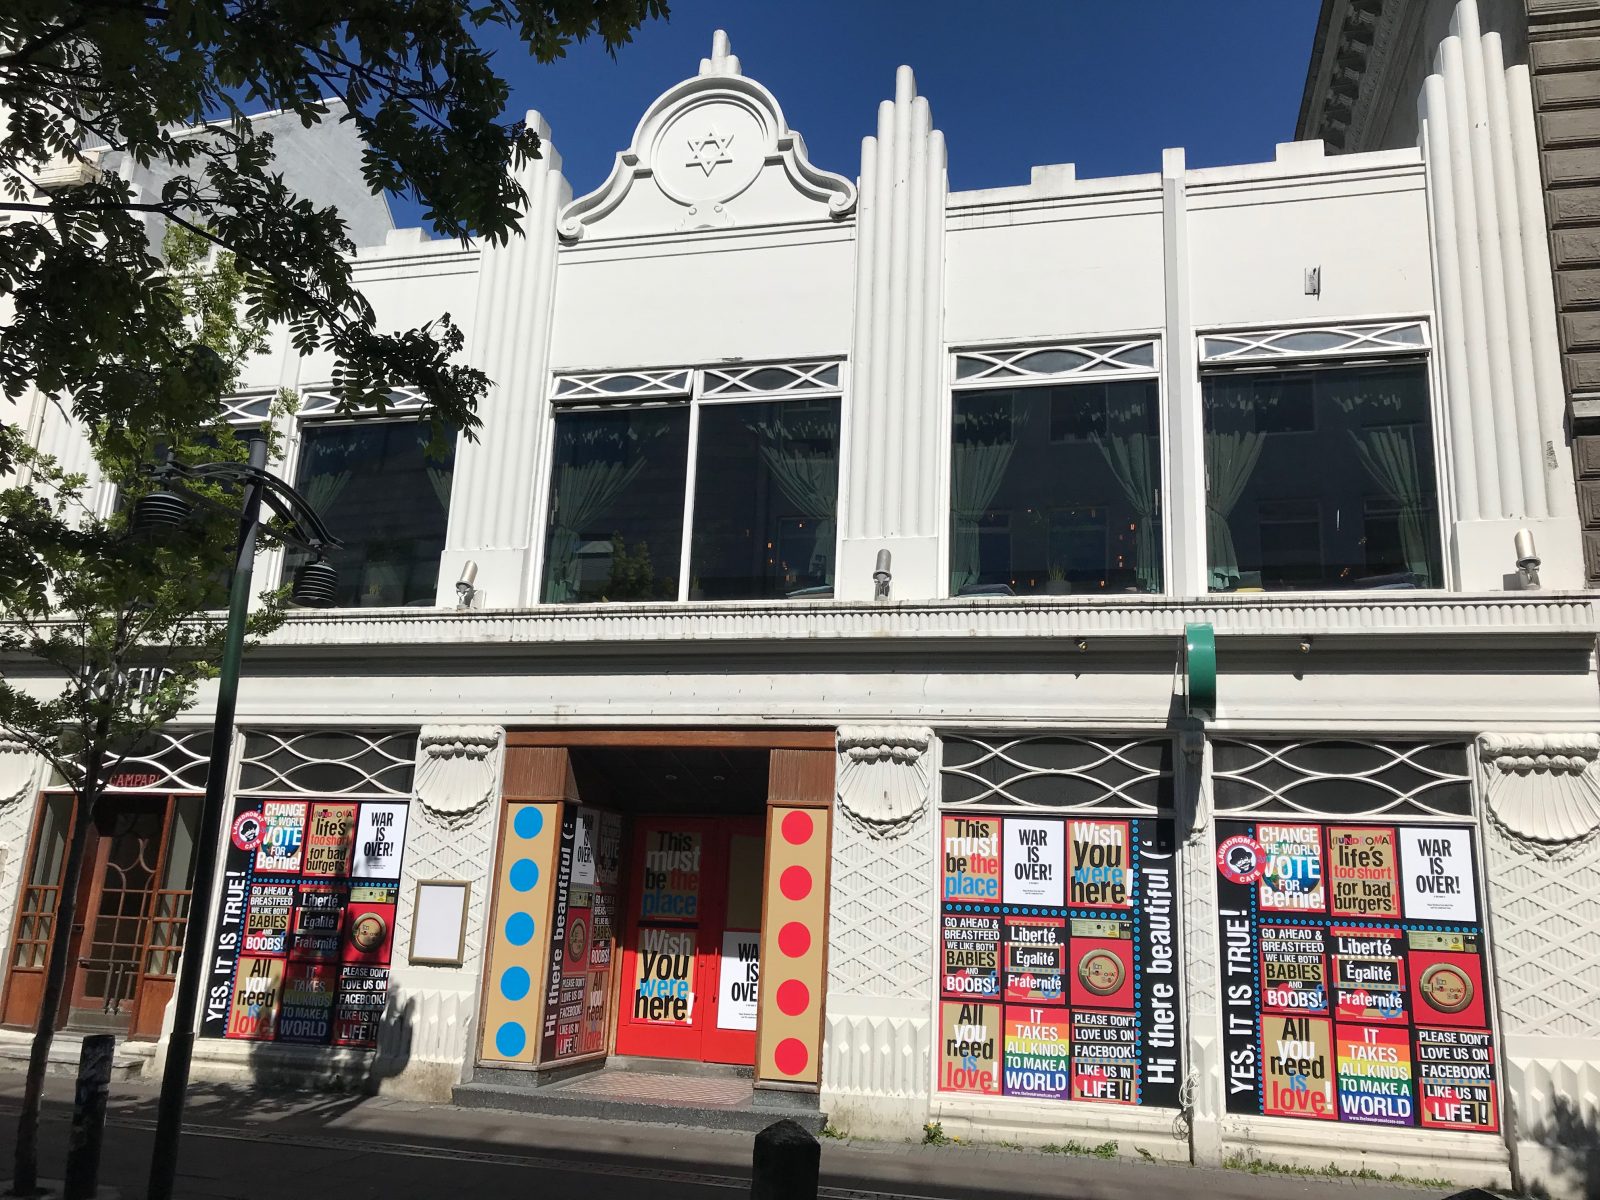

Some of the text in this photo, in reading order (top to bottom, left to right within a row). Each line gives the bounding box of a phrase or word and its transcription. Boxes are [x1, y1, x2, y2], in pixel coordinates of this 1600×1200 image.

[265, 804, 306, 816] CHANGE
[371, 812, 394, 826] WAR
[264, 816, 305, 827] THE WORLD
[315, 818, 346, 836] life's
[954, 819, 989, 838] This
[263, 826, 302, 846] VOTE
[310, 835, 349, 846] too short
[375, 827, 385, 841] IS
[657, 831, 692, 851] This
[1019, 830, 1047, 846] WAR
[1074, 822, 1122, 846] Wish
[1260, 827, 1318, 842] CHANGE
[245, 839, 260, 849] CAFE
[271, 846, 286, 856] FOR
[364, 842, 394, 856] OVER!
[945, 832, 998, 856] must
[1218, 838, 1260, 864] LAUNDROMAT
[1261, 842, 1320, 855] THE WORLD
[1417, 838, 1452, 857] WAR
[257, 852, 302, 870] Bernie!
[309, 847, 346, 860] for bad
[646, 847, 700, 872] must
[1028, 847, 1039, 863] IS
[1074, 840, 1121, 870] you
[1339, 845, 1383, 867] life's
[306, 858, 349, 874] burgers!
[946, 853, 997, 874] be the
[1015, 863, 1052, 881] OVER!
[1265, 855, 1320, 878] VOTE
[1335, 865, 1392, 880] too short
[1429, 857, 1444, 875] IS
[645, 868, 666, 890] be
[670, 869, 698, 891] the
[1074, 865, 1123, 884] were
[1240, 870, 1260, 882] CAFE
[945, 870, 997, 898] place
[1071, 869, 1133, 906] here!
[1278, 880, 1300, 891] FOR
[1337, 881, 1390, 898] for bad
[1416, 875, 1460, 895] OVER!
[642, 891, 697, 917] place
[1260, 886, 1325, 909] Bernie!
[1334, 894, 1396, 914] burgers!
[945, 917, 998, 929] GO AHEAD &
[246, 936, 284, 950] BOOBS!
[545, 848, 571, 1037] Hi there beautiful
[644, 928, 691, 956] Wish
[945, 930, 1000, 941] BREASTFEED
[1011, 926, 1056, 944] Liberté
[1262, 928, 1322, 941] GO AHEAD &
[206, 871, 246, 1022] YES, IT IS TRUE!
[738, 944, 759, 962] WA
[947, 942, 994, 951] WE LIKE BOTH
[1262, 941, 1324, 953] BREASTFEED
[1338, 937, 1392, 956] Liberté
[641, 950, 690, 983] you
[947, 950, 995, 967] BABIES
[1016, 948, 1054, 968] Égalité
[1266, 954, 1319, 964] WE LIKE BOTH
[746, 963, 759, 982] IS
[1142, 868, 1176, 1084] Hi there beautiful
[1266, 963, 1322, 981] BABIES
[1347, 960, 1392, 983] Égalité
[640, 979, 689, 1000] were
[947, 976, 995, 992] BOOBS!
[1008, 974, 1062, 991] Fraternité
[731, 982, 757, 1002] OVE
[1267, 991, 1322, 1008] BOOBS!
[1338, 991, 1403, 1008] Fraternité
[634, 989, 695, 1024] here!
[1220, 909, 1256, 1094] YES, IT IS TRUE!
[958, 1004, 983, 1026] All
[1030, 1009, 1043, 1024] IT
[1074, 1015, 1136, 1027] PLEASE DON'T
[954, 1024, 986, 1048] you
[1015, 1024, 1058, 1041] TAKES
[1075, 1029, 1134, 1041] LOVE US ON
[1282, 1018, 1310, 1041] All
[1364, 1028, 1379, 1045] IT
[1419, 1032, 1490, 1046] PLEASE DON'T
[947, 1039, 993, 1059] need
[1007, 1041, 1066, 1057] ALL KINDS
[1075, 1044, 1135, 1058] FACEBOOK!
[1276, 1039, 1315, 1065] you
[1348, 1045, 1398, 1063] TAKES
[1421, 1047, 1489, 1061] LOVE US ON
[963, 1050, 977, 1072] is
[1007, 1057, 1066, 1072] TO MAKE A
[1270, 1055, 1325, 1079] need
[947, 1062, 997, 1091] love!
[1078, 1063, 1130, 1078] LIKE US IN
[1341, 1063, 1408, 1080] ALL KINDS
[1422, 1064, 1491, 1079] FACEBOOK!
[1006, 1072, 1066, 1092] WORLD
[1083, 1081, 1130, 1100] LIFE !
[1290, 1073, 1307, 1092] is
[1340, 1078, 1410, 1097] TO MAKE A
[1272, 1081, 1332, 1113] love!
[1427, 1086, 1487, 1101] LIKE US IN
[1341, 1096, 1410, 1118] WORLD
[1433, 1103, 1487, 1124] LIFE !
